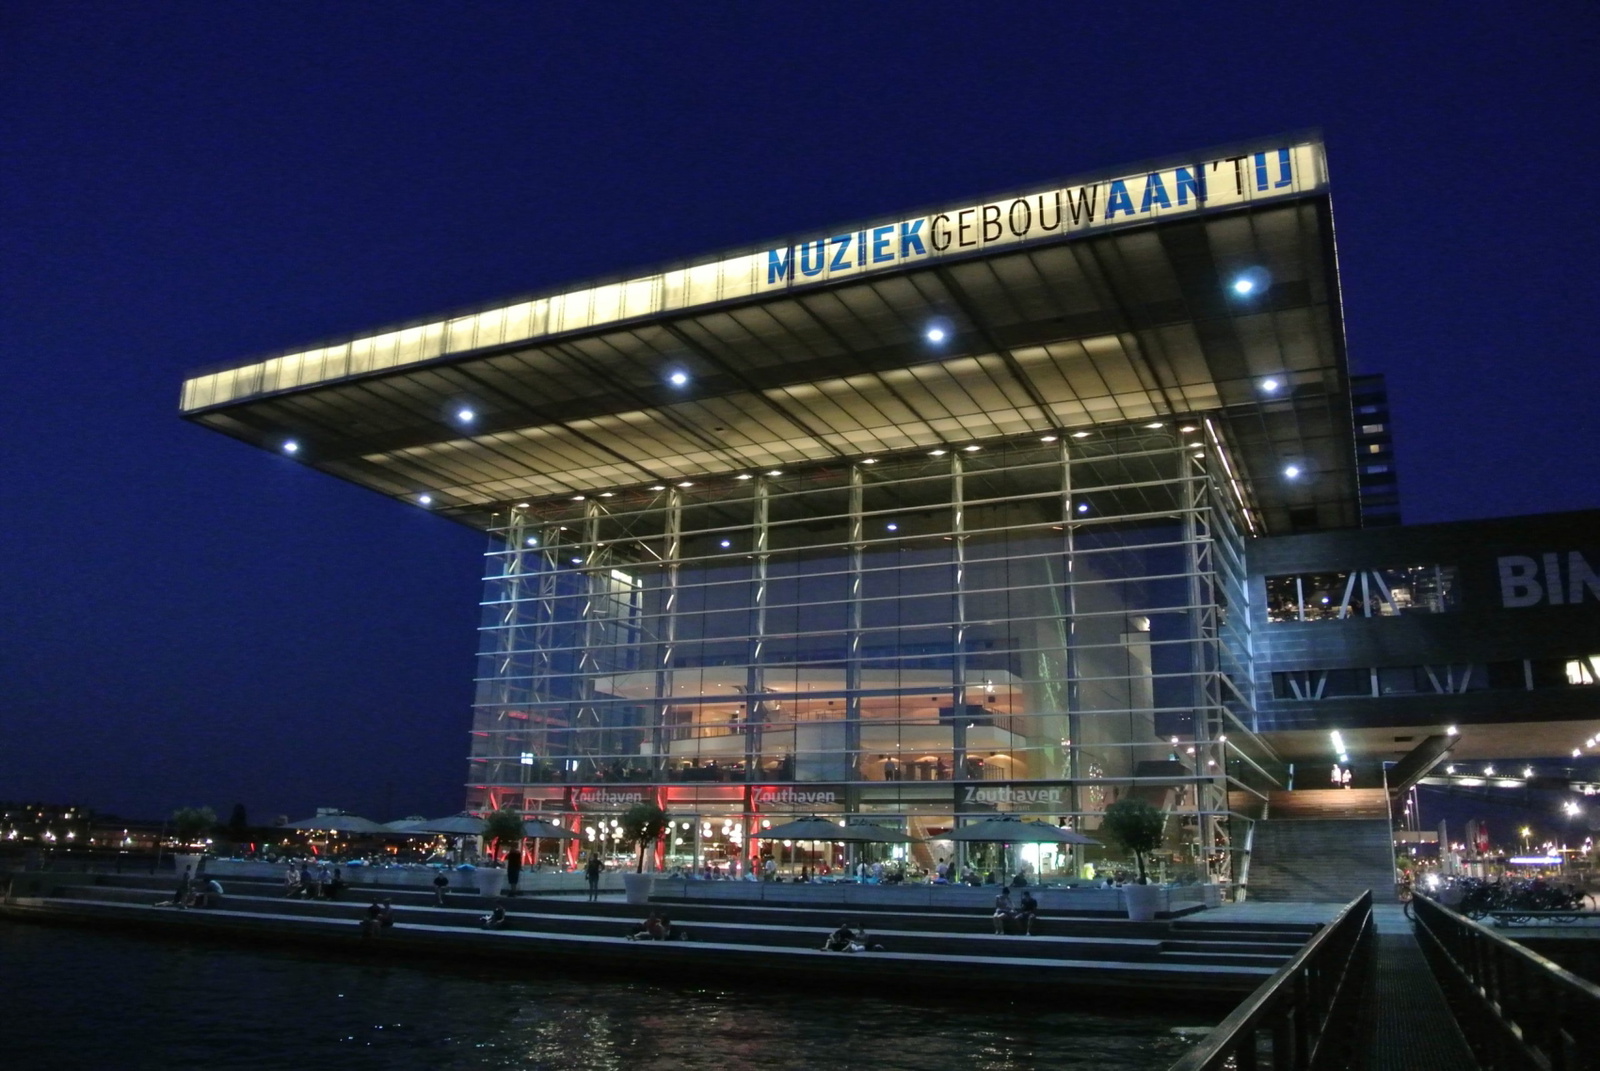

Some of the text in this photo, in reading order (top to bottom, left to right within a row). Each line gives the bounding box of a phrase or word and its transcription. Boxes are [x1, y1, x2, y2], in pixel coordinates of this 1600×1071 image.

[571, 787, 642, 803] Zouthaven
[754, 787, 835, 803] Zouthaven
[964, 784, 1060, 803] Zouthaven
